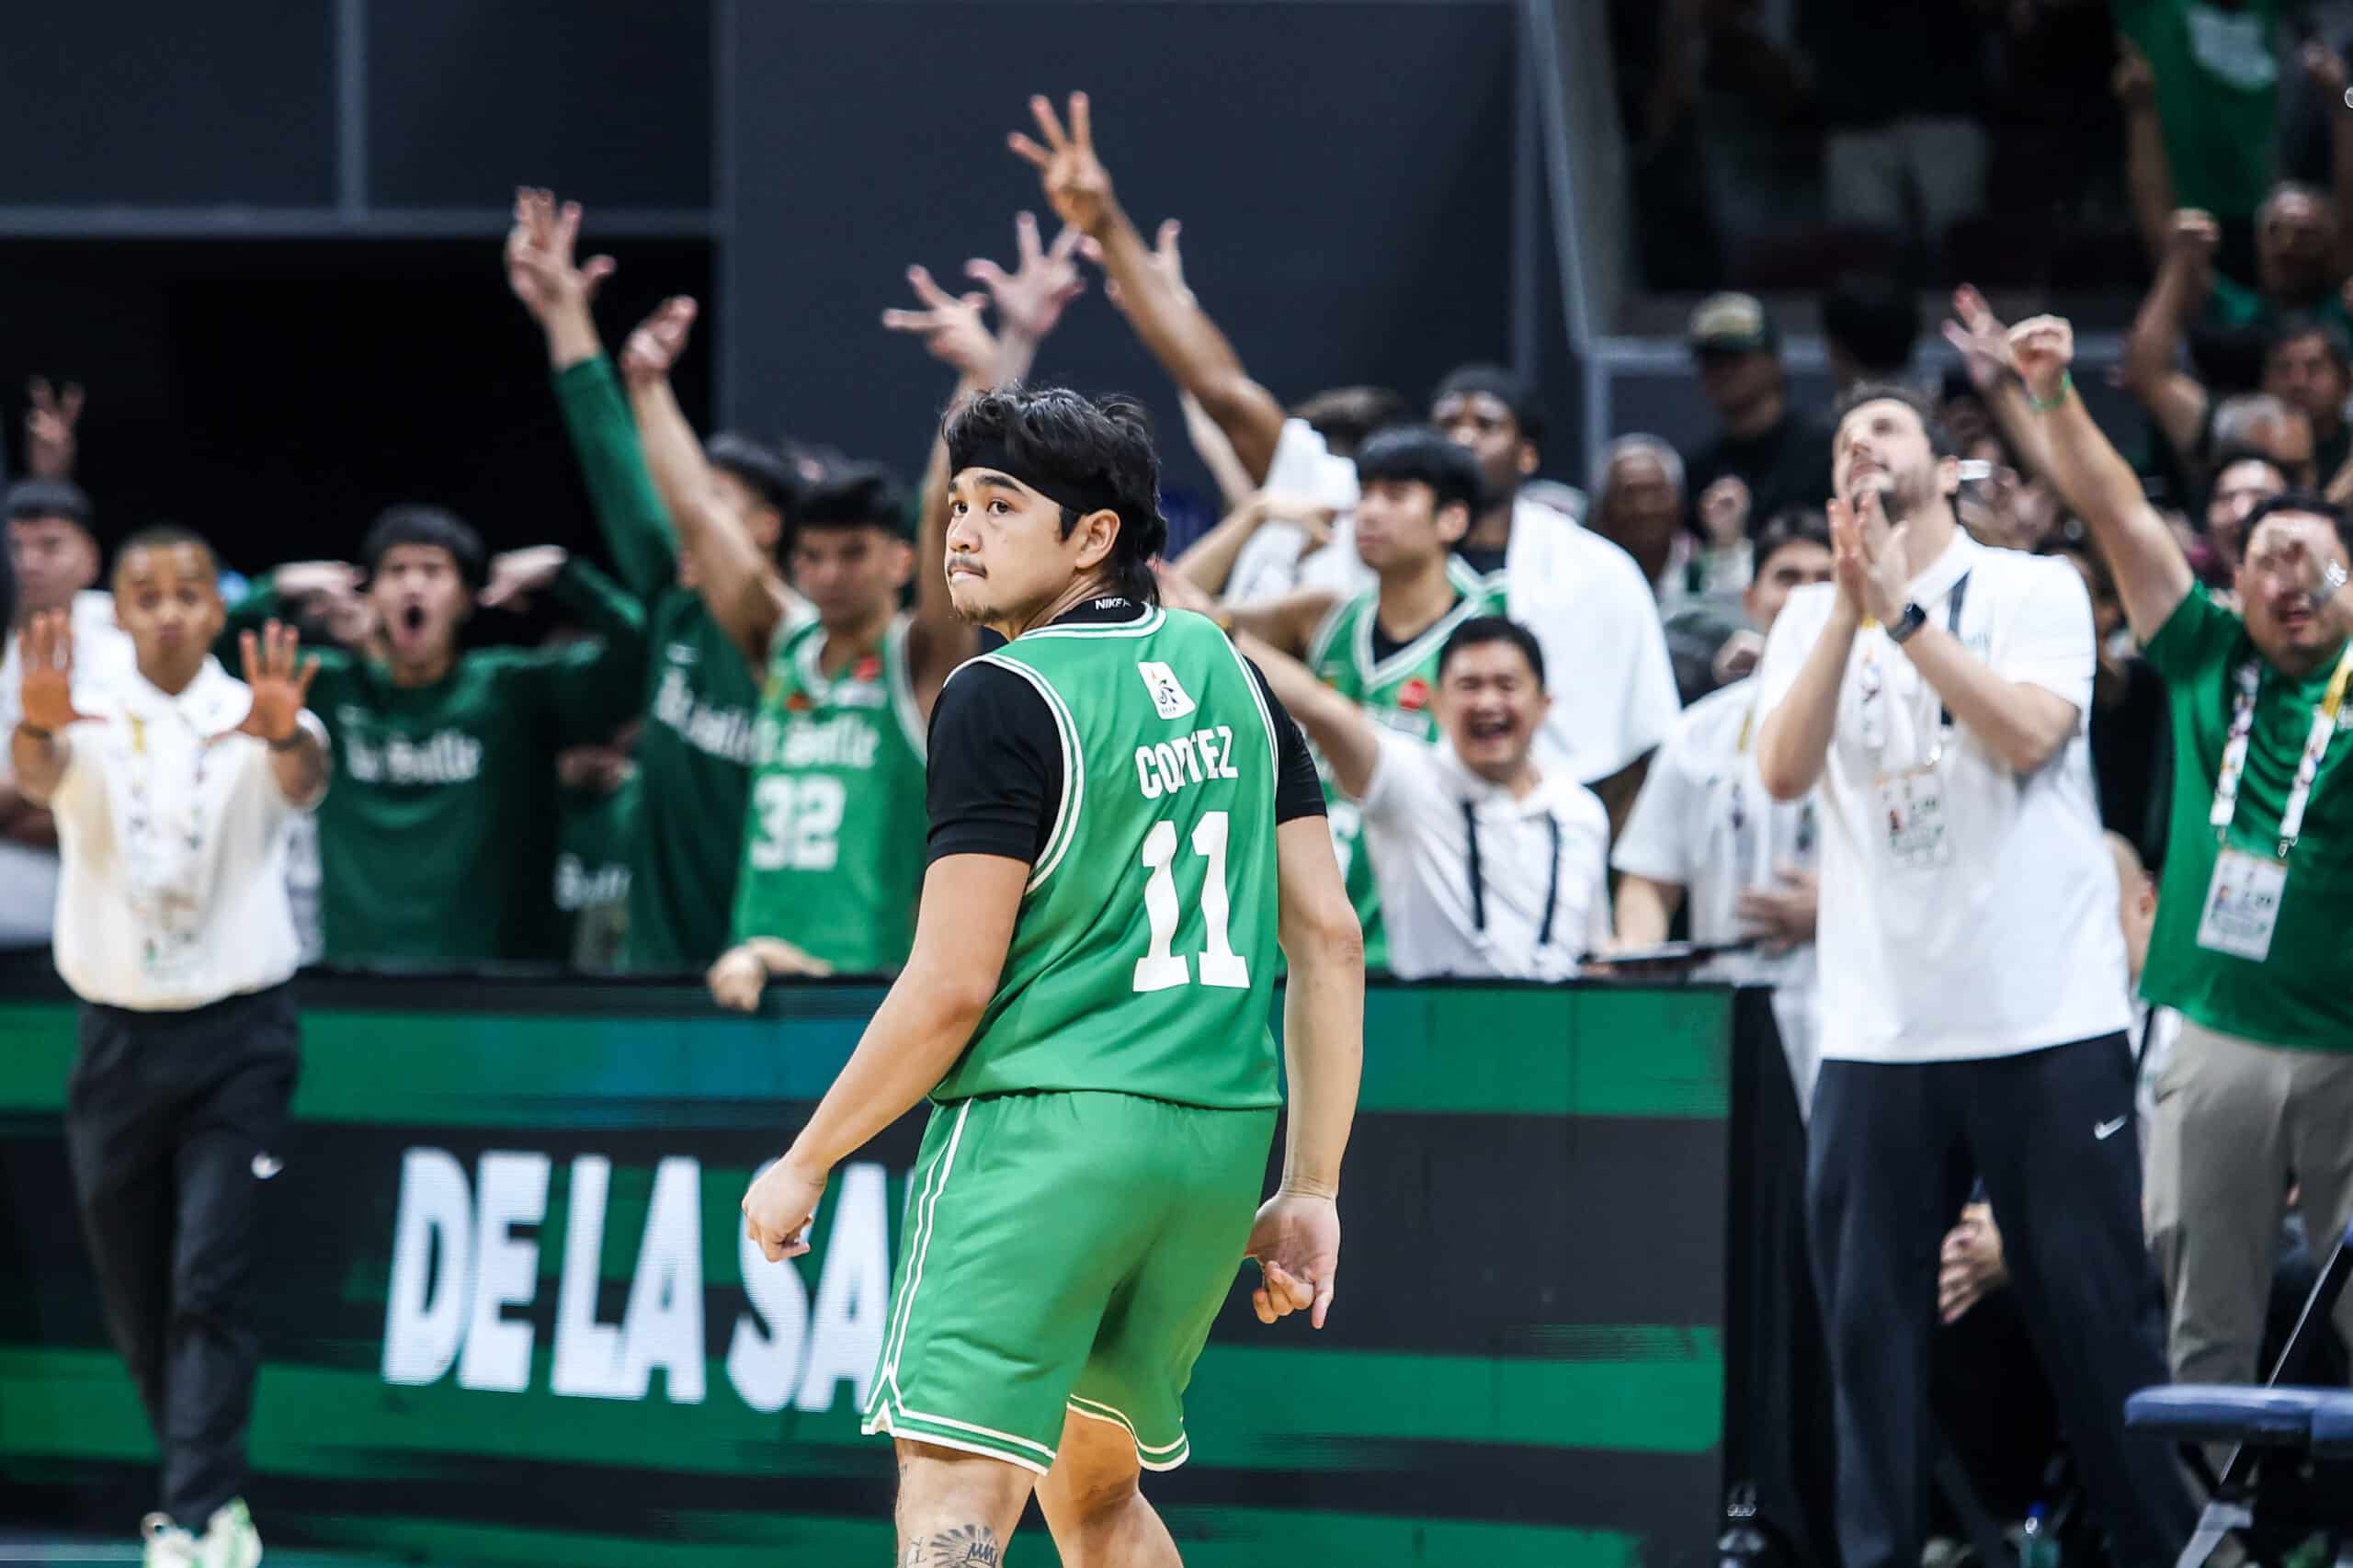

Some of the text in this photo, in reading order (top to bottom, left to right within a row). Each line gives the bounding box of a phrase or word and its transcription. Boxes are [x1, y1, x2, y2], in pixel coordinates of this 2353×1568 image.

[751, 773, 847, 870] 32
[1135, 725, 1239, 800] CORTEZ
[1132, 811, 1251, 992] 11
[382, 1147, 551, 1393] DE
[551, 1154, 706, 1403] LA
